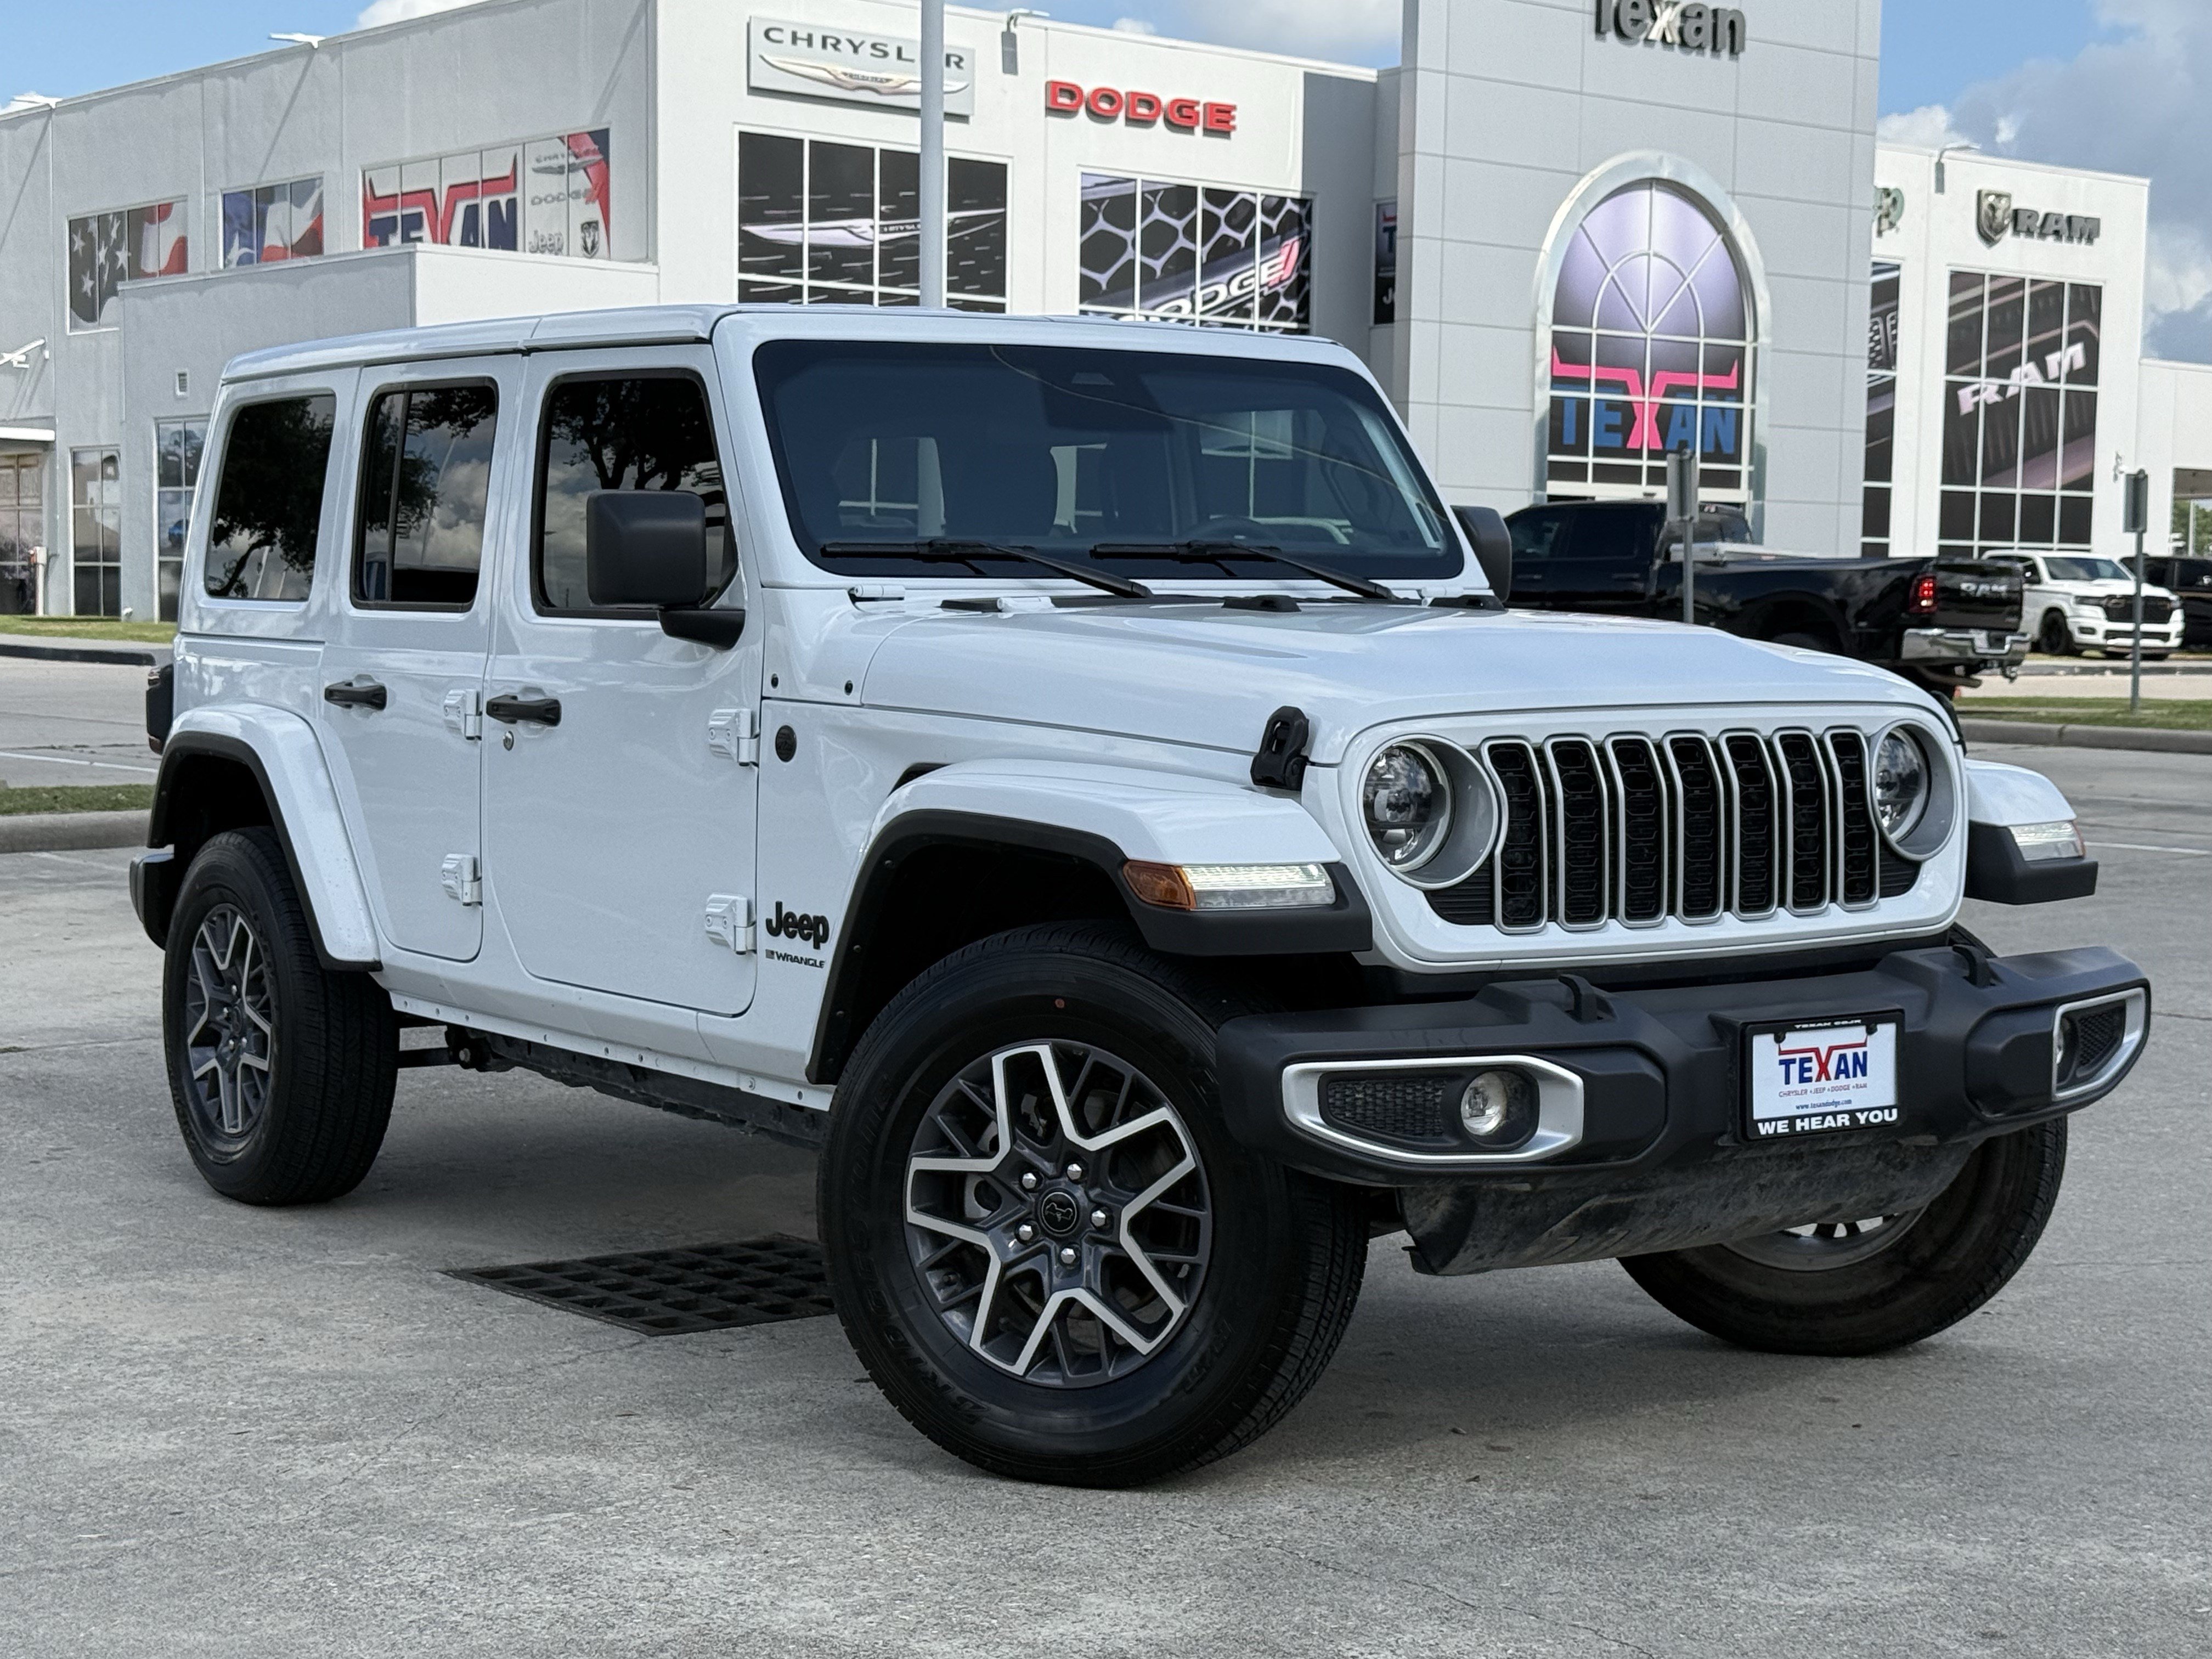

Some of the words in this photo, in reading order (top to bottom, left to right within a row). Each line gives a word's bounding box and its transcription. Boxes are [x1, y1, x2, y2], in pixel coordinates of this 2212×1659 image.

[763, 26, 965, 70] CHRYSLR
[1045, 80, 1237, 135] DODGE
[529, 230, 565, 256] Jeep
[2012, 208, 2101, 245] RAM
[1118, 252, 1285, 323] ODGE
[1550, 345, 1738, 454] TEXAN
[1957, 341, 2085, 416] RAM
[765, 901, 830, 950] Jeep
[1778, 1035, 1867, 1085] TEXAN
[1779, 1088, 1808, 1098] CHRYSLER
[1813, 1085, 1826, 1094] JEEP
[1831, 1084, 1851, 1093] DODGE
[1757, 1120, 1790, 1135] WE
[1796, 1114, 1850, 1132] HEAR
[1857, 1108, 1898, 1125] YOU
